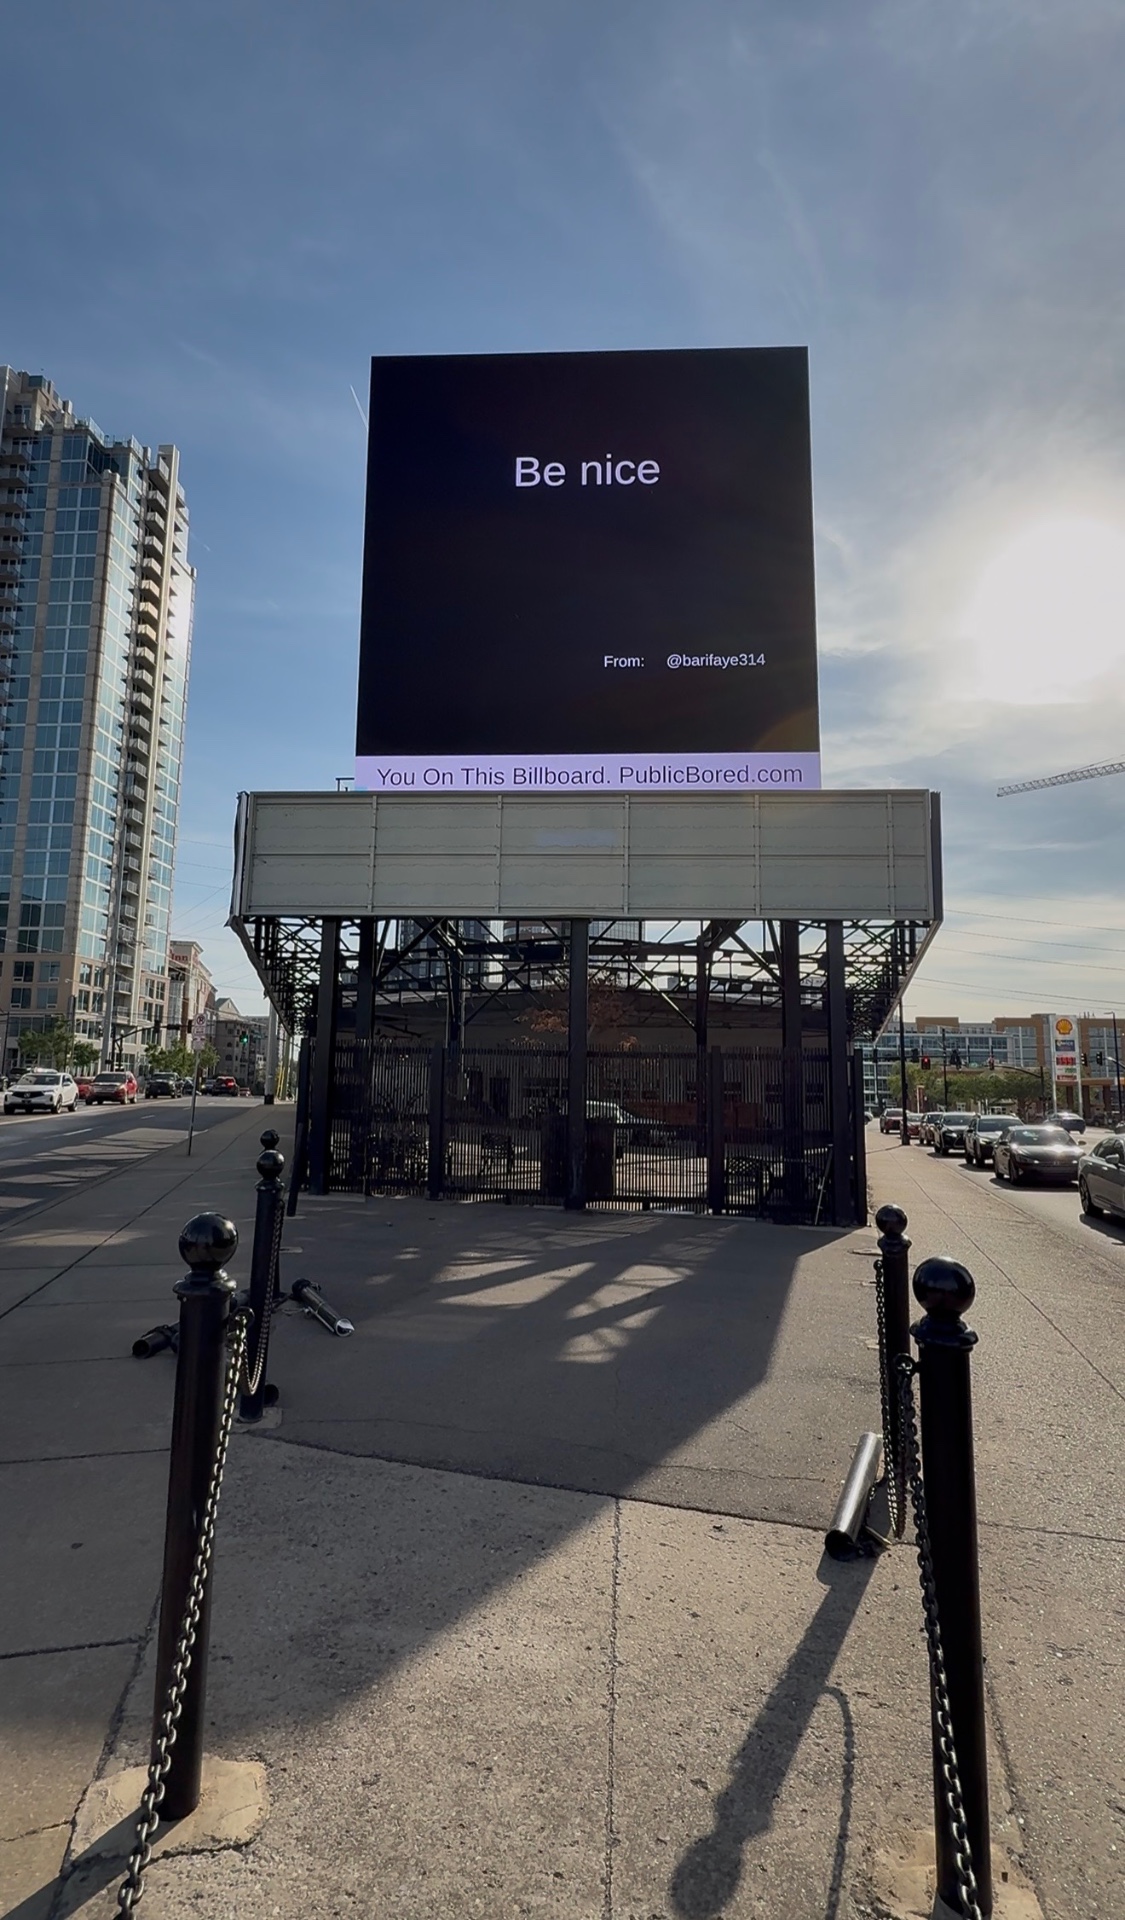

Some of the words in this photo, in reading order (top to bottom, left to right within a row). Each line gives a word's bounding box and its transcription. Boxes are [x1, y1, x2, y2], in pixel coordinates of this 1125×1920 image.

[515, 456, 566, 487] Be
[581, 453, 661, 486] nice
[604, 655, 645, 668] From:
[666, 653, 766, 670] @barifaye314
[377, 768, 415, 786] You
[423, 768, 454, 786] On
[460, 767, 505, 785] This
[513, 766, 612, 785] Billboard.
[620, 765, 803, 784] PublicBored.com
